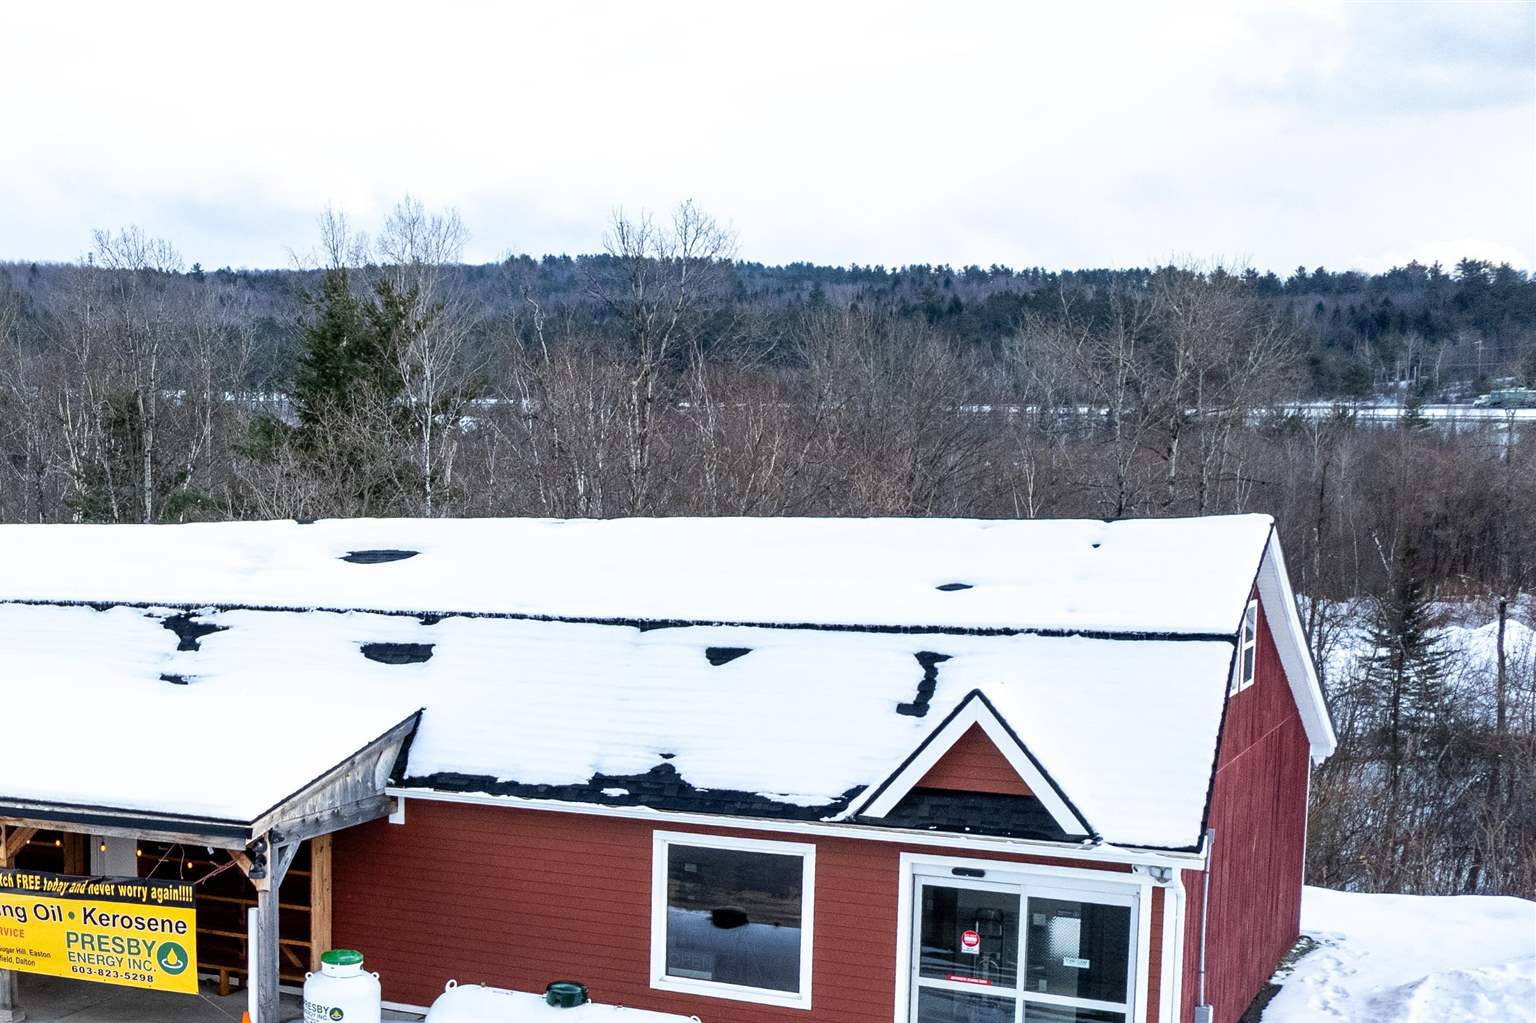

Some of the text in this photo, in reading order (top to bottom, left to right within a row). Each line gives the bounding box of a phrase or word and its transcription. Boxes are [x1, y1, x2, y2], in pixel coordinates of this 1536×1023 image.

[16, 874, 41, 891] FREE
[43, 876, 68, 896] today
[68, 880, 88, 895] and
[88, 881, 116, 896] never
[117, 884, 148, 903] worry
[150, 885, 193, 903] again!!!!
[33, 903, 63, 922] Oil
[82, 906, 187, 935] Kerosene
[16, 947, 28, 956] Hill,
[66, 931, 157, 957] PRESBY
[15, 957, 36, 966] Dalton
[68, 951, 158, 972] ENERGY INC.
[71, 965, 154, 982] 603-823-5298
